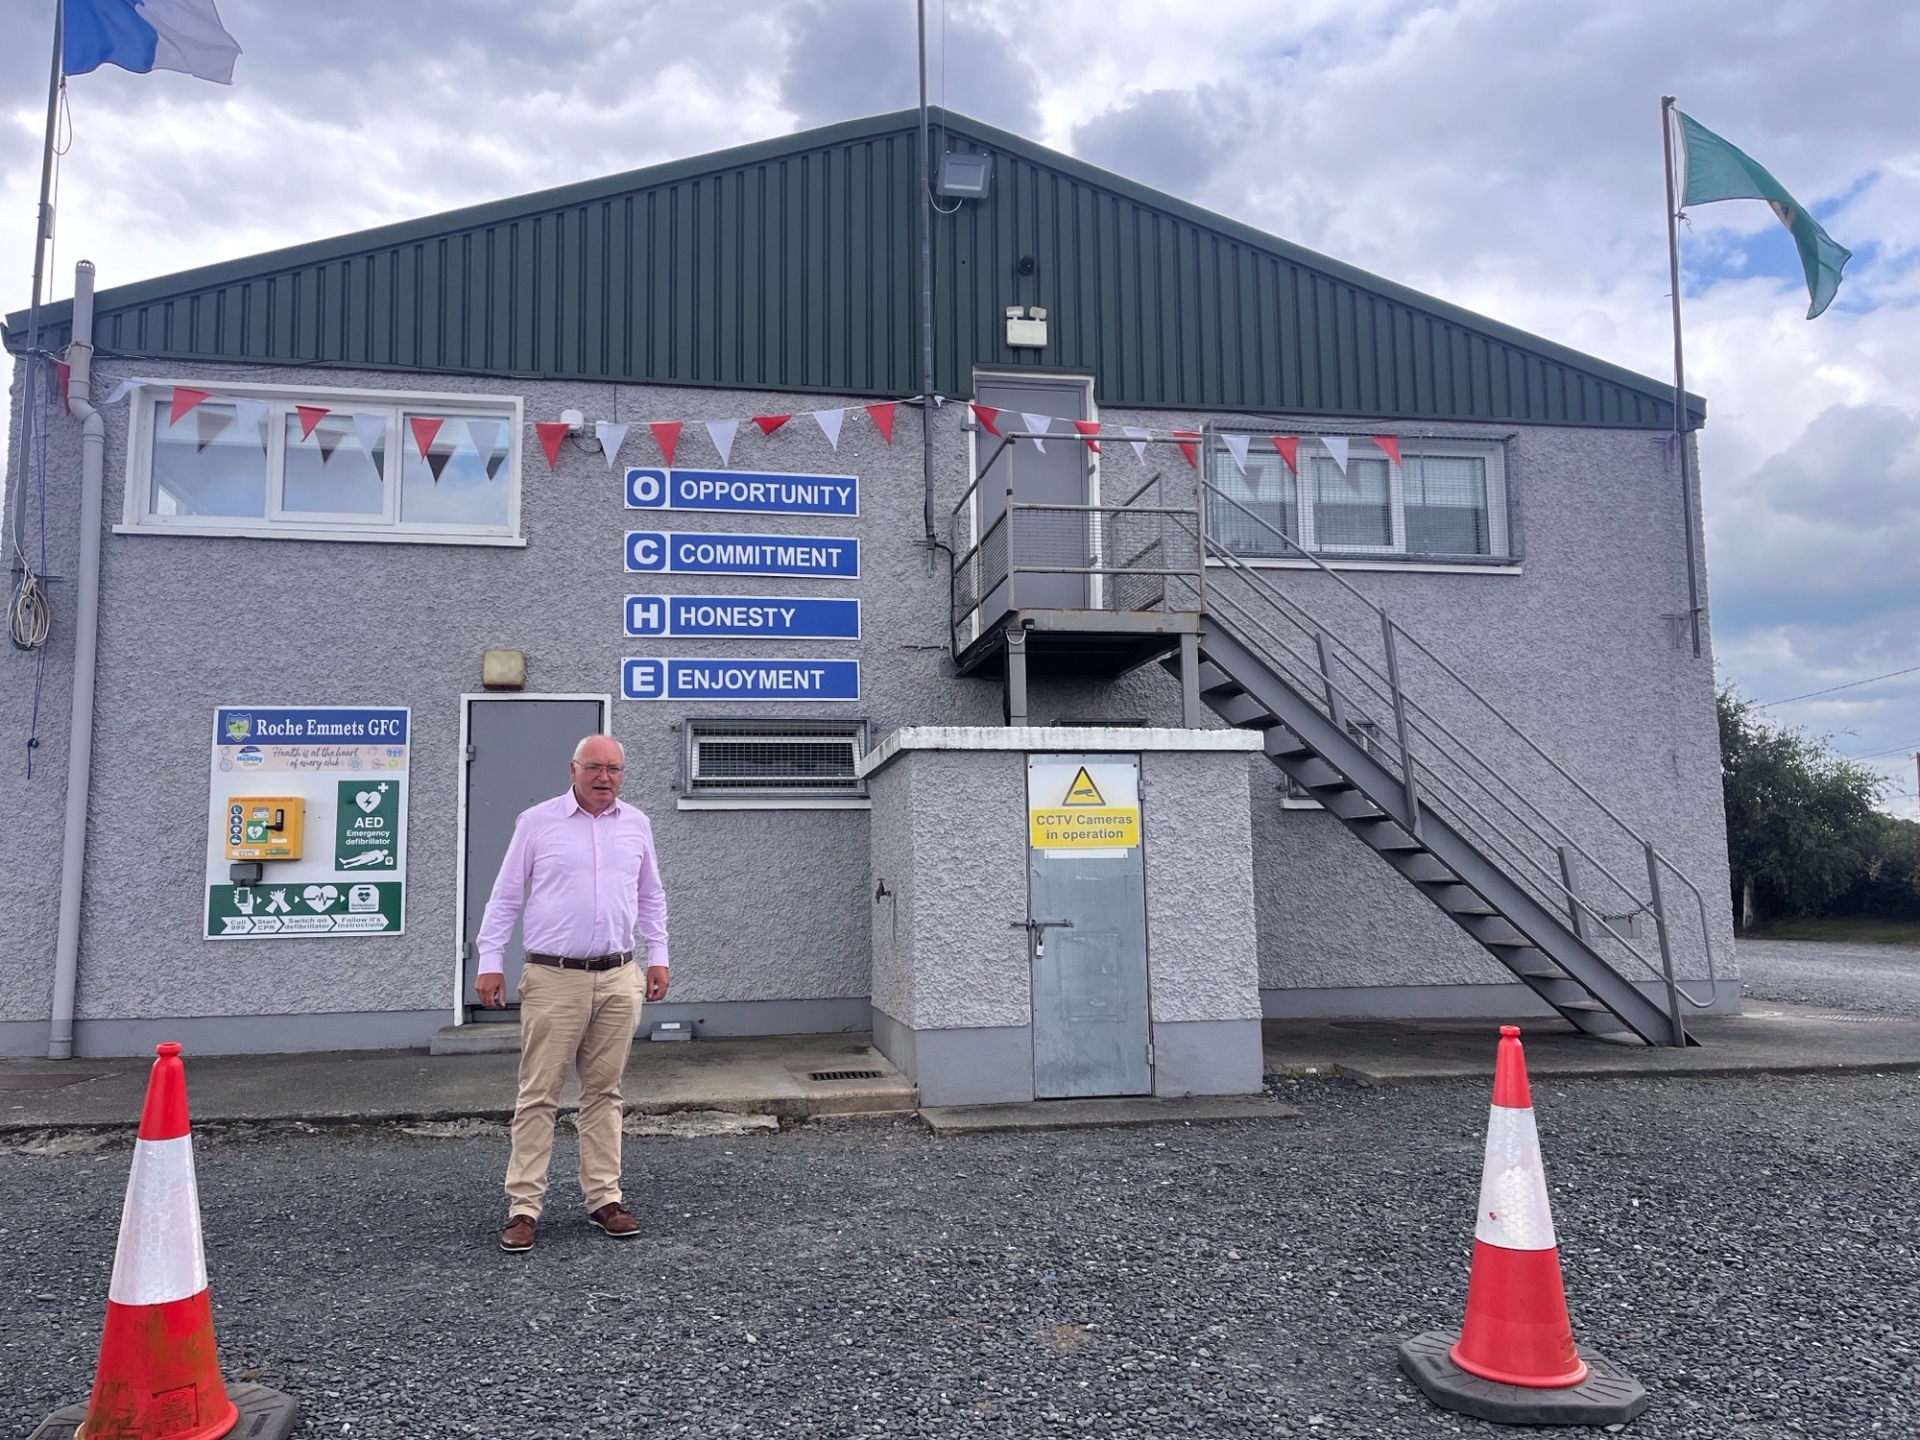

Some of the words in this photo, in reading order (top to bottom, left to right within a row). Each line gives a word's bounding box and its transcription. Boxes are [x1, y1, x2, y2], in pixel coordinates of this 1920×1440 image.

[633, 476, 660, 501] O
[680, 480, 851, 506] OPPORTUNITY
[634, 539, 659, 565] C
[679, 543, 842, 568] COMMITMENT
[633, 603, 659, 629] H
[680, 606, 796, 628] HONESTY
[632, 666, 655, 692] E
[678, 669, 825, 690] ENJOYMENT
[256, 719, 303, 736] Roche
[306, 719, 364, 736] Emmets
[368, 719, 400, 736] GFC
[272, 746, 300, 757] Health
[302, 748, 309, 758] is
[311, 747, 320, 757] at
[321, 747, 335, 757] the
[335, 747, 359, 757] heart
[237, 755, 263, 763] Healthy
[290, 758, 298, 769] of
[300, 760, 322, 770] every
[323, 757, 340, 766] club
[354, 817, 384, 828] AED
[1036, 814, 1072, 825] CCTV
[1076, 814, 1133, 825] Cameras
[346, 829, 390, 837] Emergency
[1046, 829, 1058, 839] in
[1062, 828, 1123, 841] operation
